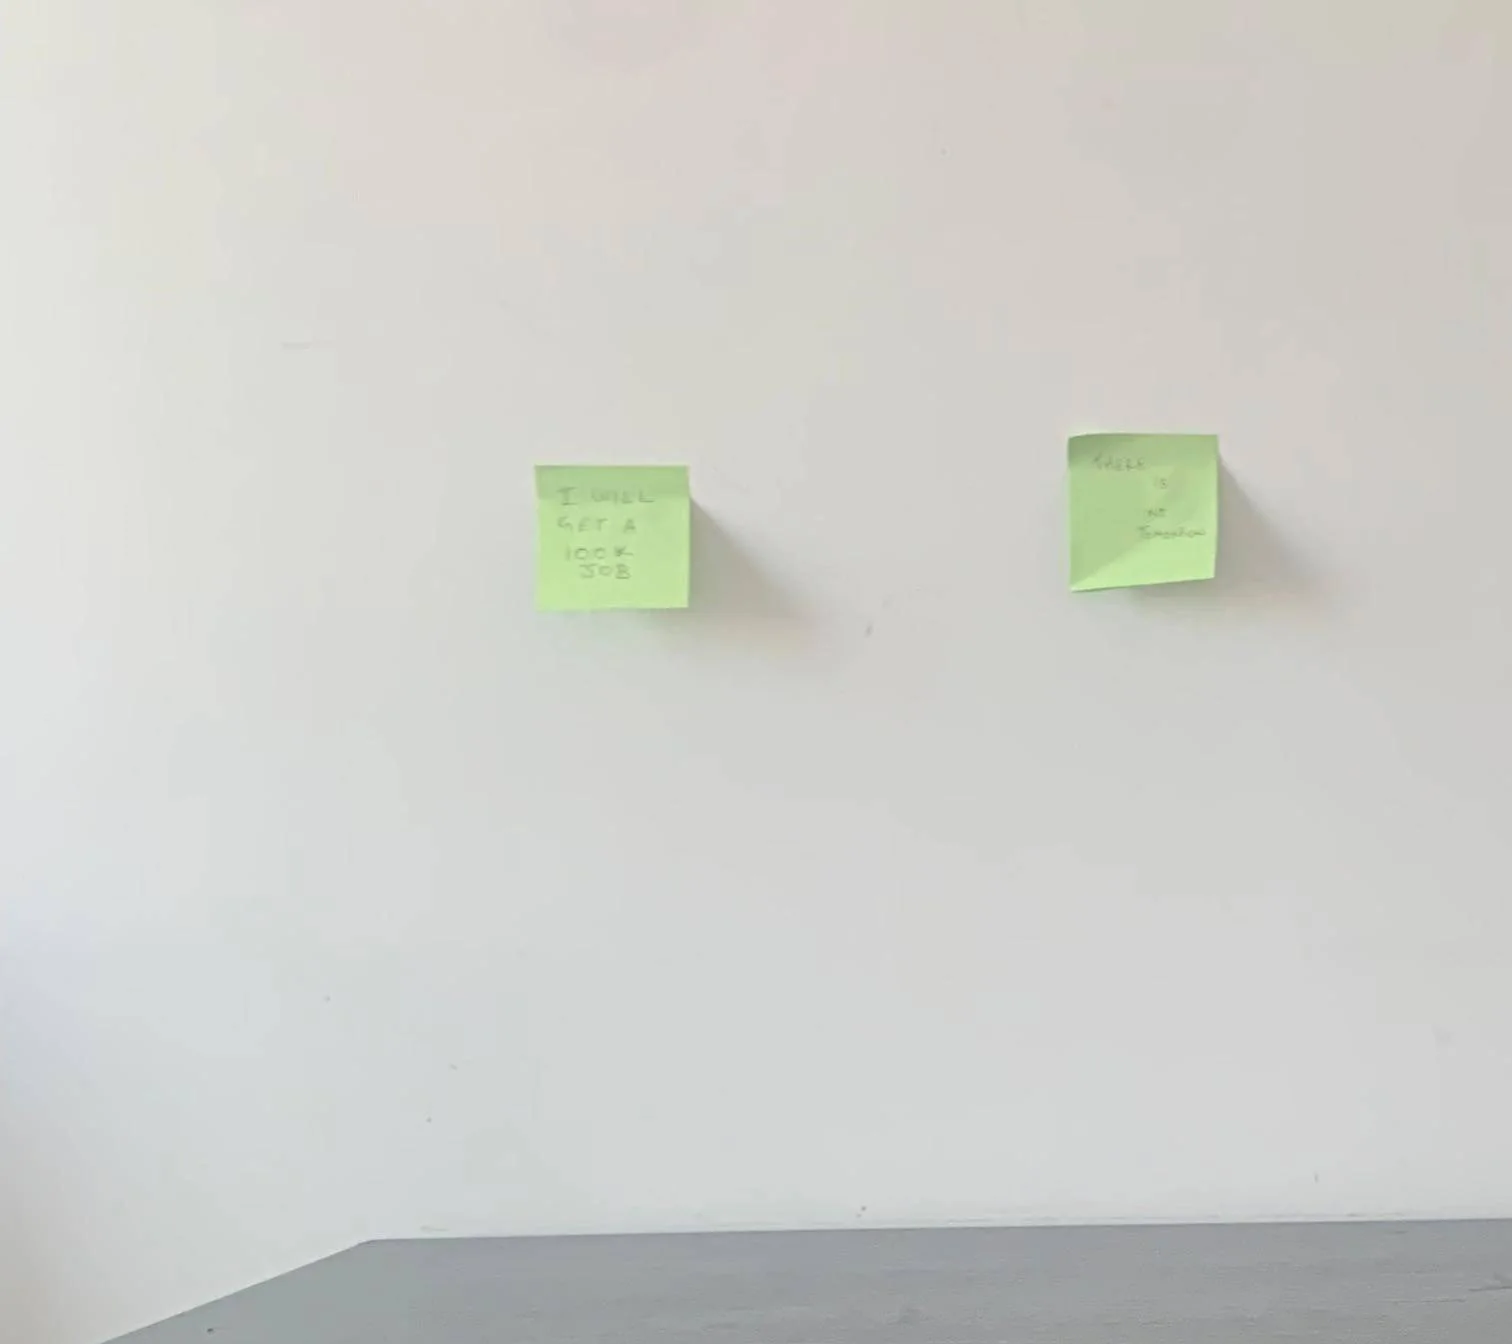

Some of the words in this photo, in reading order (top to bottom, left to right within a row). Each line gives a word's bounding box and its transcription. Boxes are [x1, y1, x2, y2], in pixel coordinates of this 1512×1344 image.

[556, 486, 579, 506] I
[590, 488, 655, 505] WILL
[556, 515, 609, 533] GET
[622, 518, 637, 534] A
[577, 562, 632, 580] JOB
